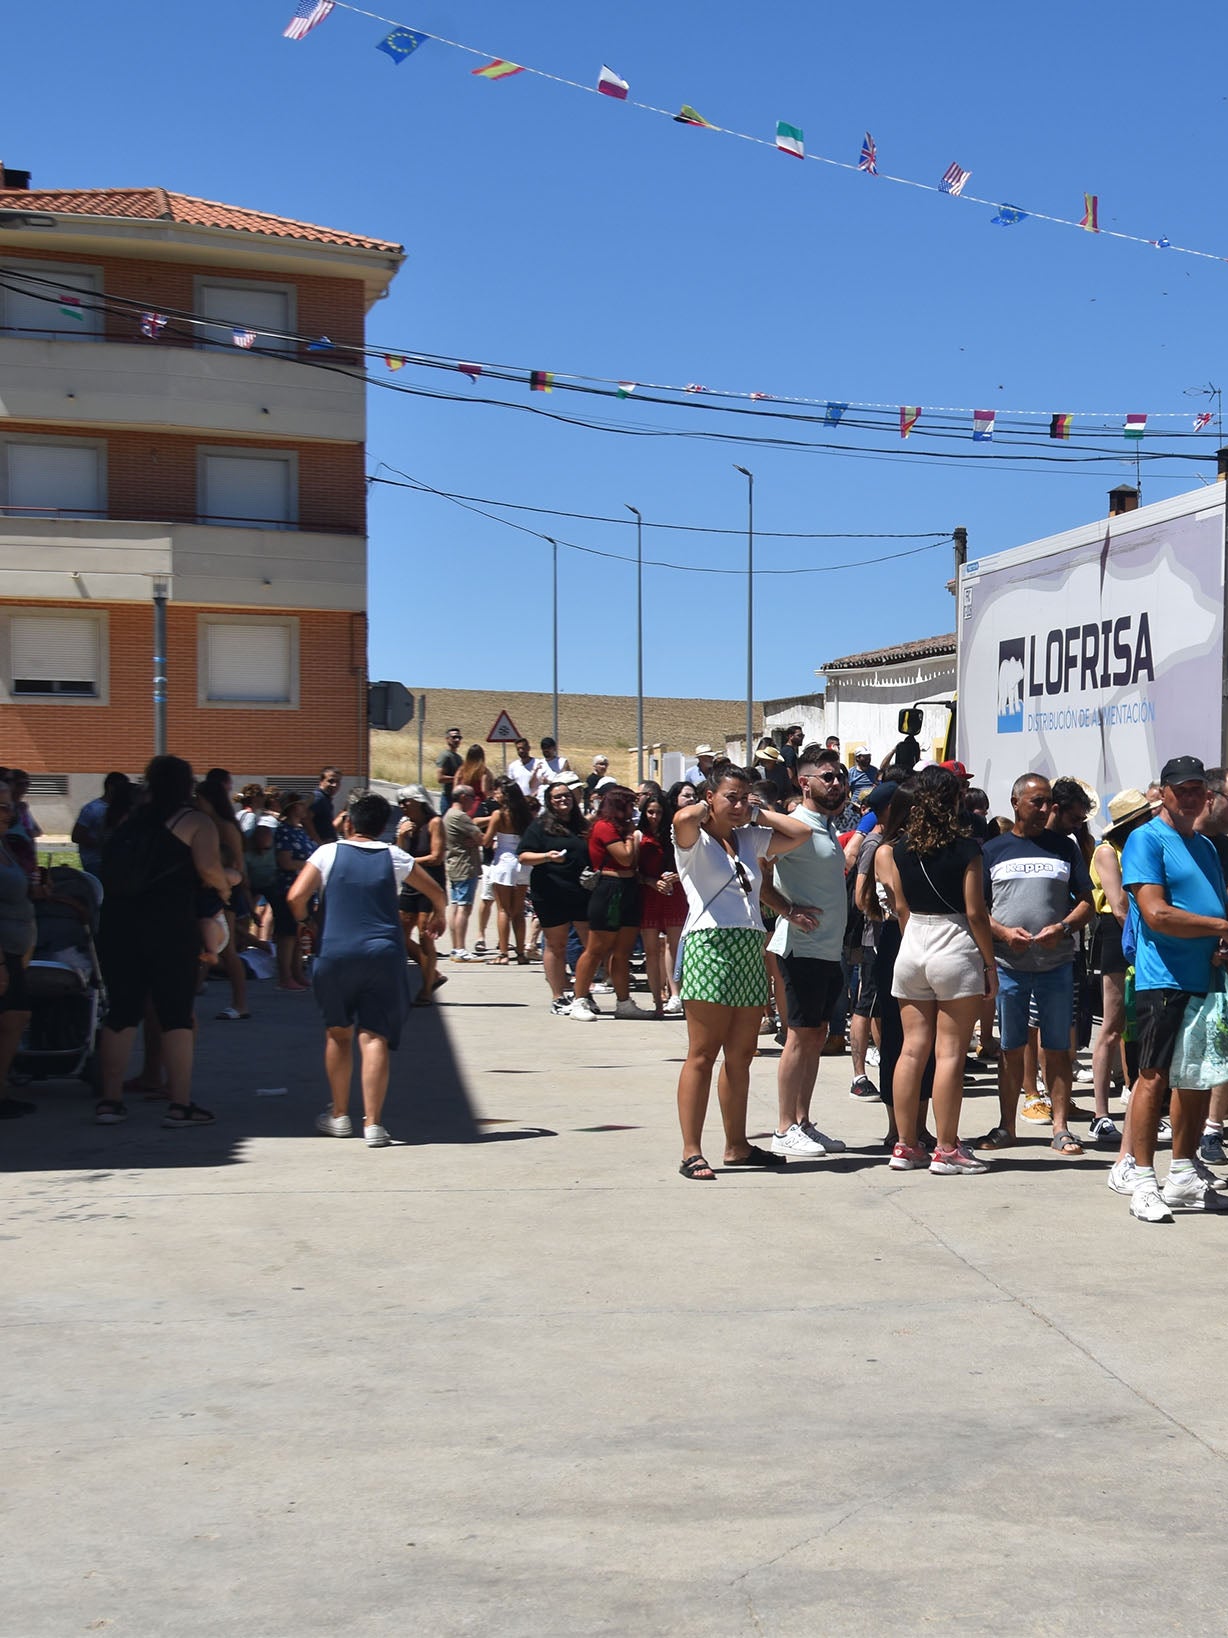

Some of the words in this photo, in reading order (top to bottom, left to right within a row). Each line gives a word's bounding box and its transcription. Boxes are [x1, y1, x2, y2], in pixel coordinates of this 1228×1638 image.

[1029, 612, 1155, 697] LOFRISA
[1028, 706, 1077, 732] DISTRIBUCIÓN
[1079, 708, 1090, 728] DE
[1092, 698, 1155, 726] ALIMENTACIÓN
[1006, 863, 1053, 873] Kappa
